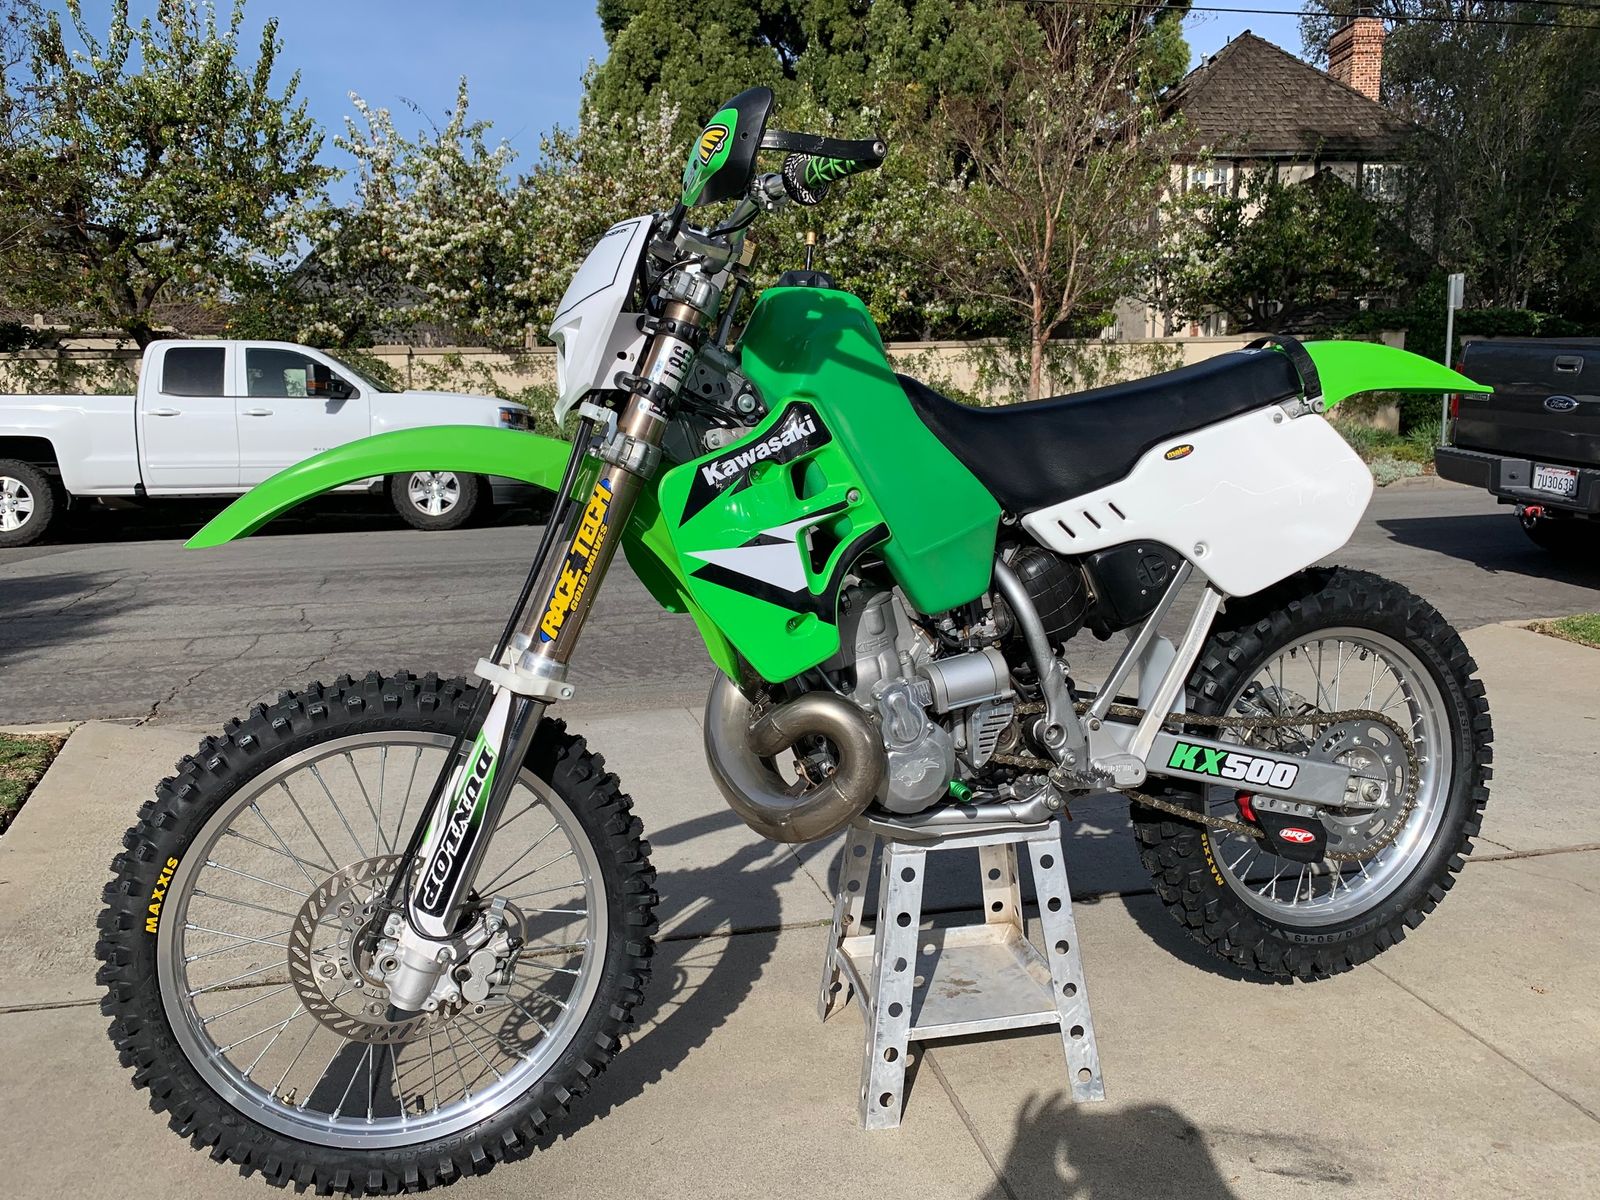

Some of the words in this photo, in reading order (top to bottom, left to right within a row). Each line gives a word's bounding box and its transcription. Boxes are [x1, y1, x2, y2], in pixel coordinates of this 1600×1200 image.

[1549, 399, 1569, 409] Ford
[701, 414, 817, 487] Kawasaki
[540, 559, 582, 641] RACE
[570, 481, 614, 558] TECH
[569, 576, 589, 612] GOLD
[584, 523, 609, 575] VALVES
[1167, 741, 1300, 790] KX500
[423, 745, 497, 910] DUNLOP
[1200, 833, 1226, 888] MAXXIS
[145, 856, 179, 934] MAXXIS
